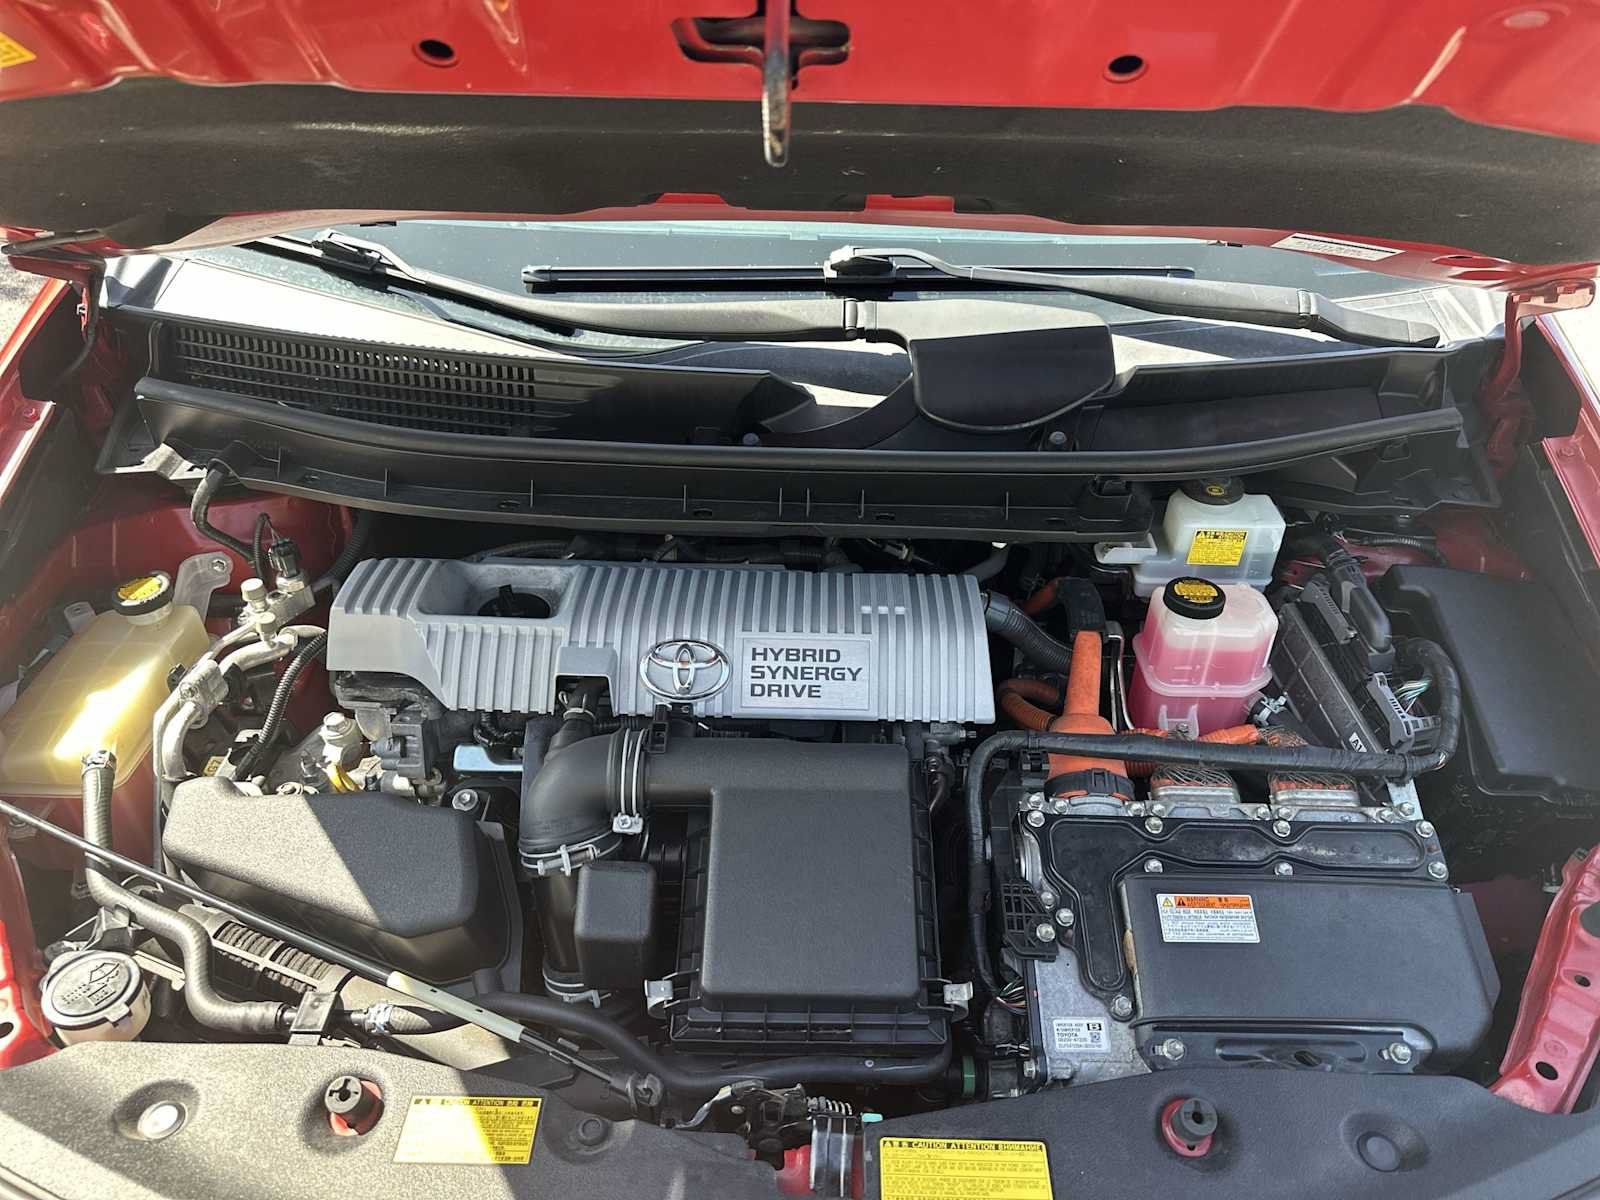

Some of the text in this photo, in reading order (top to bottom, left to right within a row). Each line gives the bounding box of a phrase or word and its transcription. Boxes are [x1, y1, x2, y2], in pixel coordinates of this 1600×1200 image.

[752, 648, 841, 663] HYBRID
[751, 665, 863, 681] SYNERGY
[750, 683, 822, 698] DRIVE
[912, 1141, 947, 1149] CAUTION
[950, 1142, 995, 1151] ATTENTION
